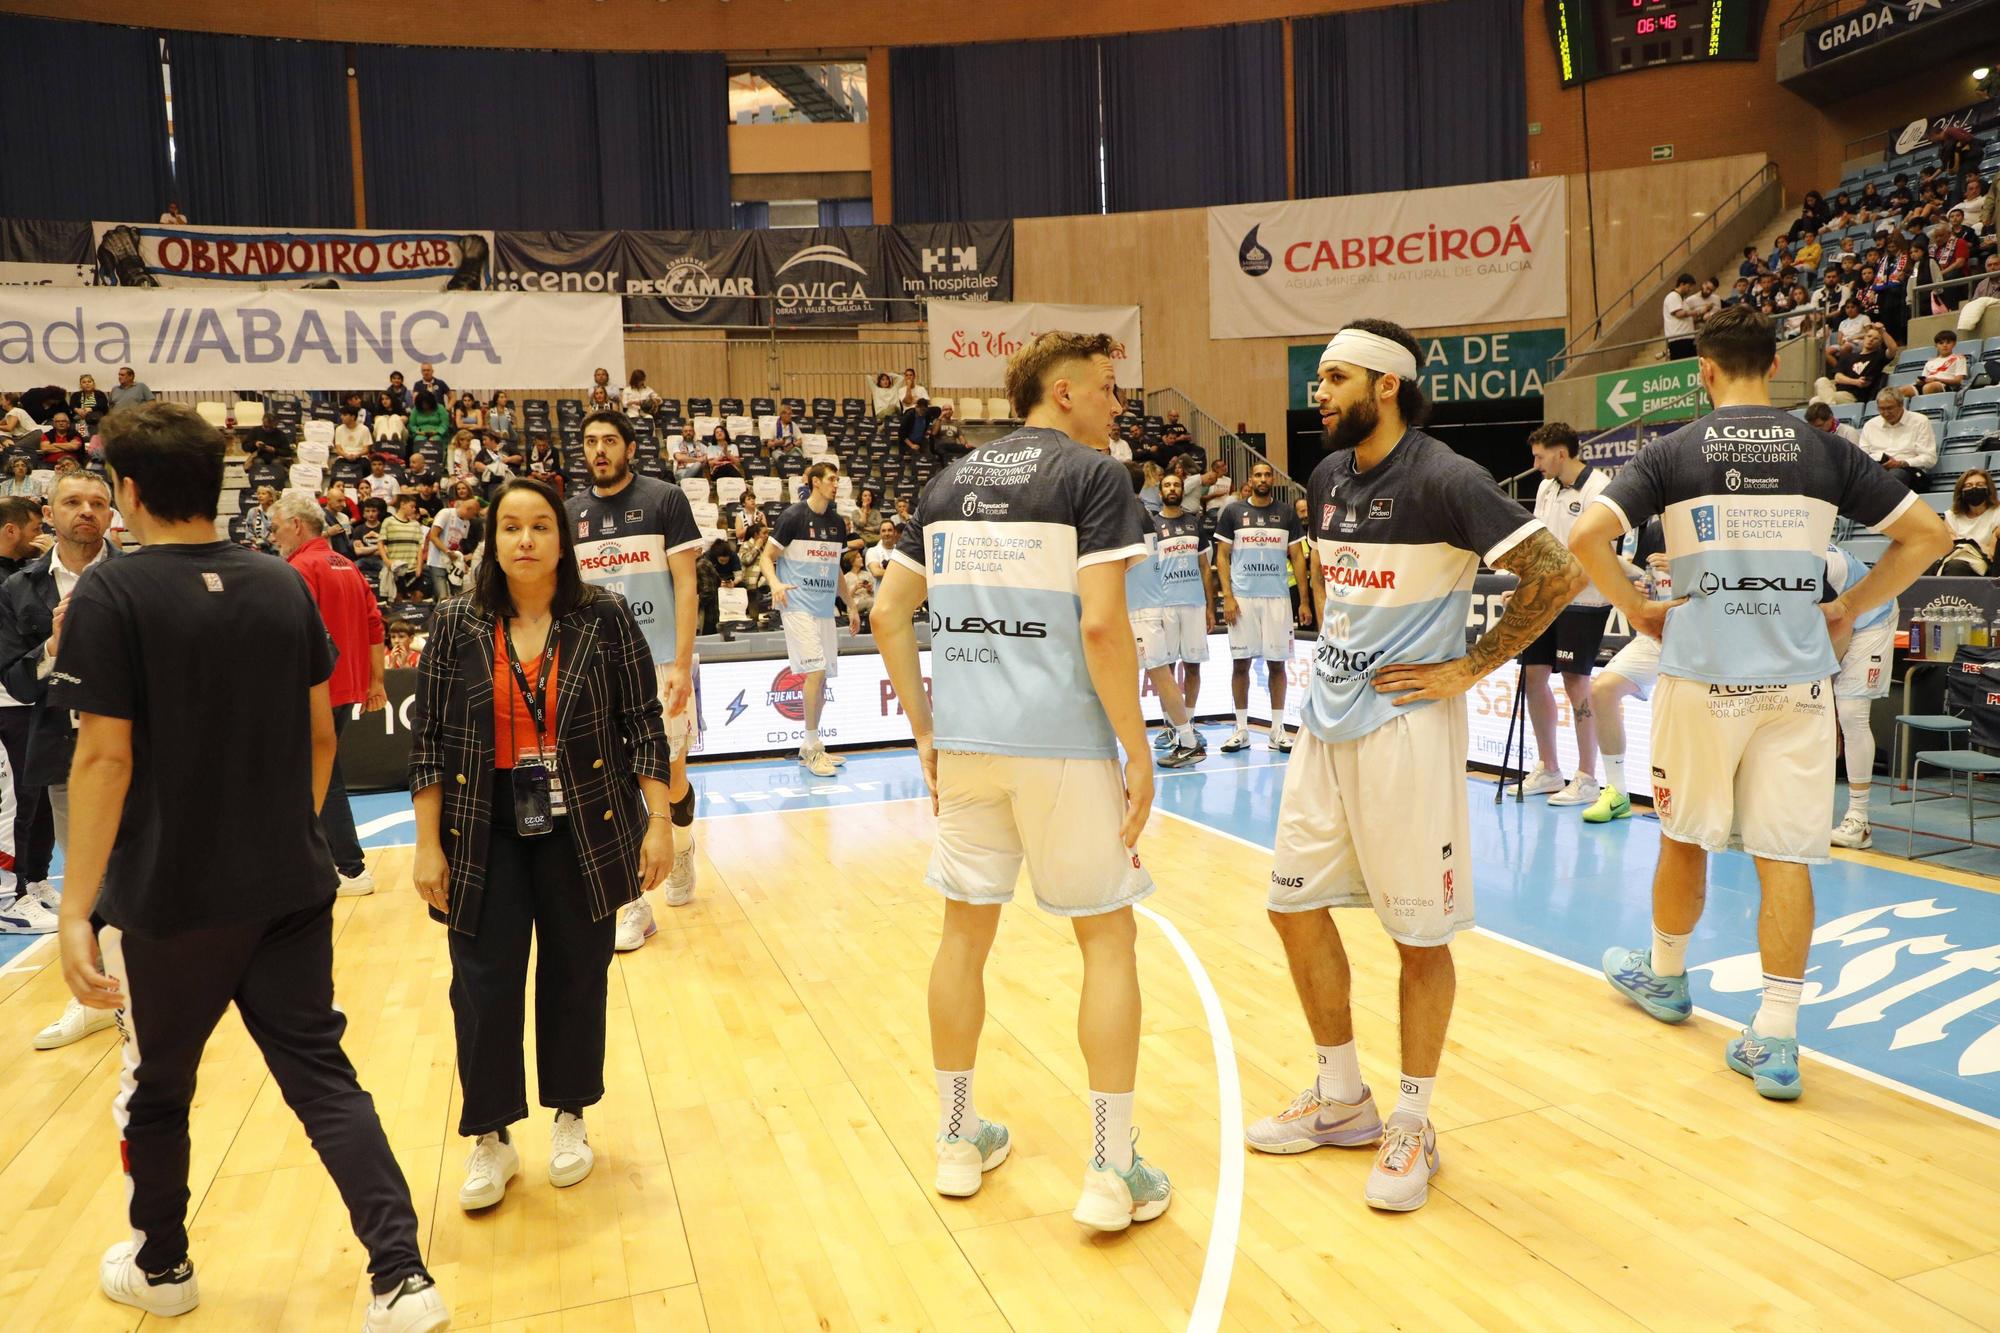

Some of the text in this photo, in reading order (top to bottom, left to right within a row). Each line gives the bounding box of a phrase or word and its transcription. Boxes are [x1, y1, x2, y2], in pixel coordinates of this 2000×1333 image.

[1637, 15, 1677, 34] 06:46
[1818, 6, 1894, 51] GRADA
[1284, 216, 1532, 273] CABREIROÁ
[158, 235, 380, 276] OBRADOIRO
[521, 271, 619, 292] cenor
[1326, 273, 1383, 287] MINERAL
[1388, 269, 1448, 282] NATURAL
[1454, 265, 1472, 277] DE
[1477, 260, 1532, 275] GALICIA
[626, 277, 755, 297] PESCAMAR
[903, 273, 998, 292] hm hospitales
[776, 280, 870, 308] OVIGA
[775, 307, 797, 315] OBRAS
[837, 304, 862, 312] GALICIA
[1642, 374, 1680, 394] SAÍDA
[1704, 426, 1795, 440] A Coruña
[967, 447, 1042, 464] A Coruña
[1702, 443, 1801, 454] UNHA PROVINCIA
[1706, 453, 1798, 463] POR DESCUBRIR
[956, 464, 1037, 476] UNHA PROVINCIA
[953, 474, 1031, 487] POR DESCUBRIR
[978, 502, 1009, 510] Deputación
[1726, 509, 1767, 518] CENTRO
[1727, 519, 1805, 528] DE HOSTELERÍA
[957, 537, 1042, 549] CENTRO SUPERIOR
[1727, 531, 1783, 539] DE GALICIA
[580, 550, 650, 571] PESCAMAR
[955, 549, 1026, 561] DE HOSTELERÍA
[1322, 564, 1395, 589] ESCAMAR
[1721, 577, 1816, 592] LEXUS
[1724, 602, 1781, 616] GALICIA
[945, 616, 1047, 638] LEXUS
[1272, 871, 1304, 888] ONBUS
